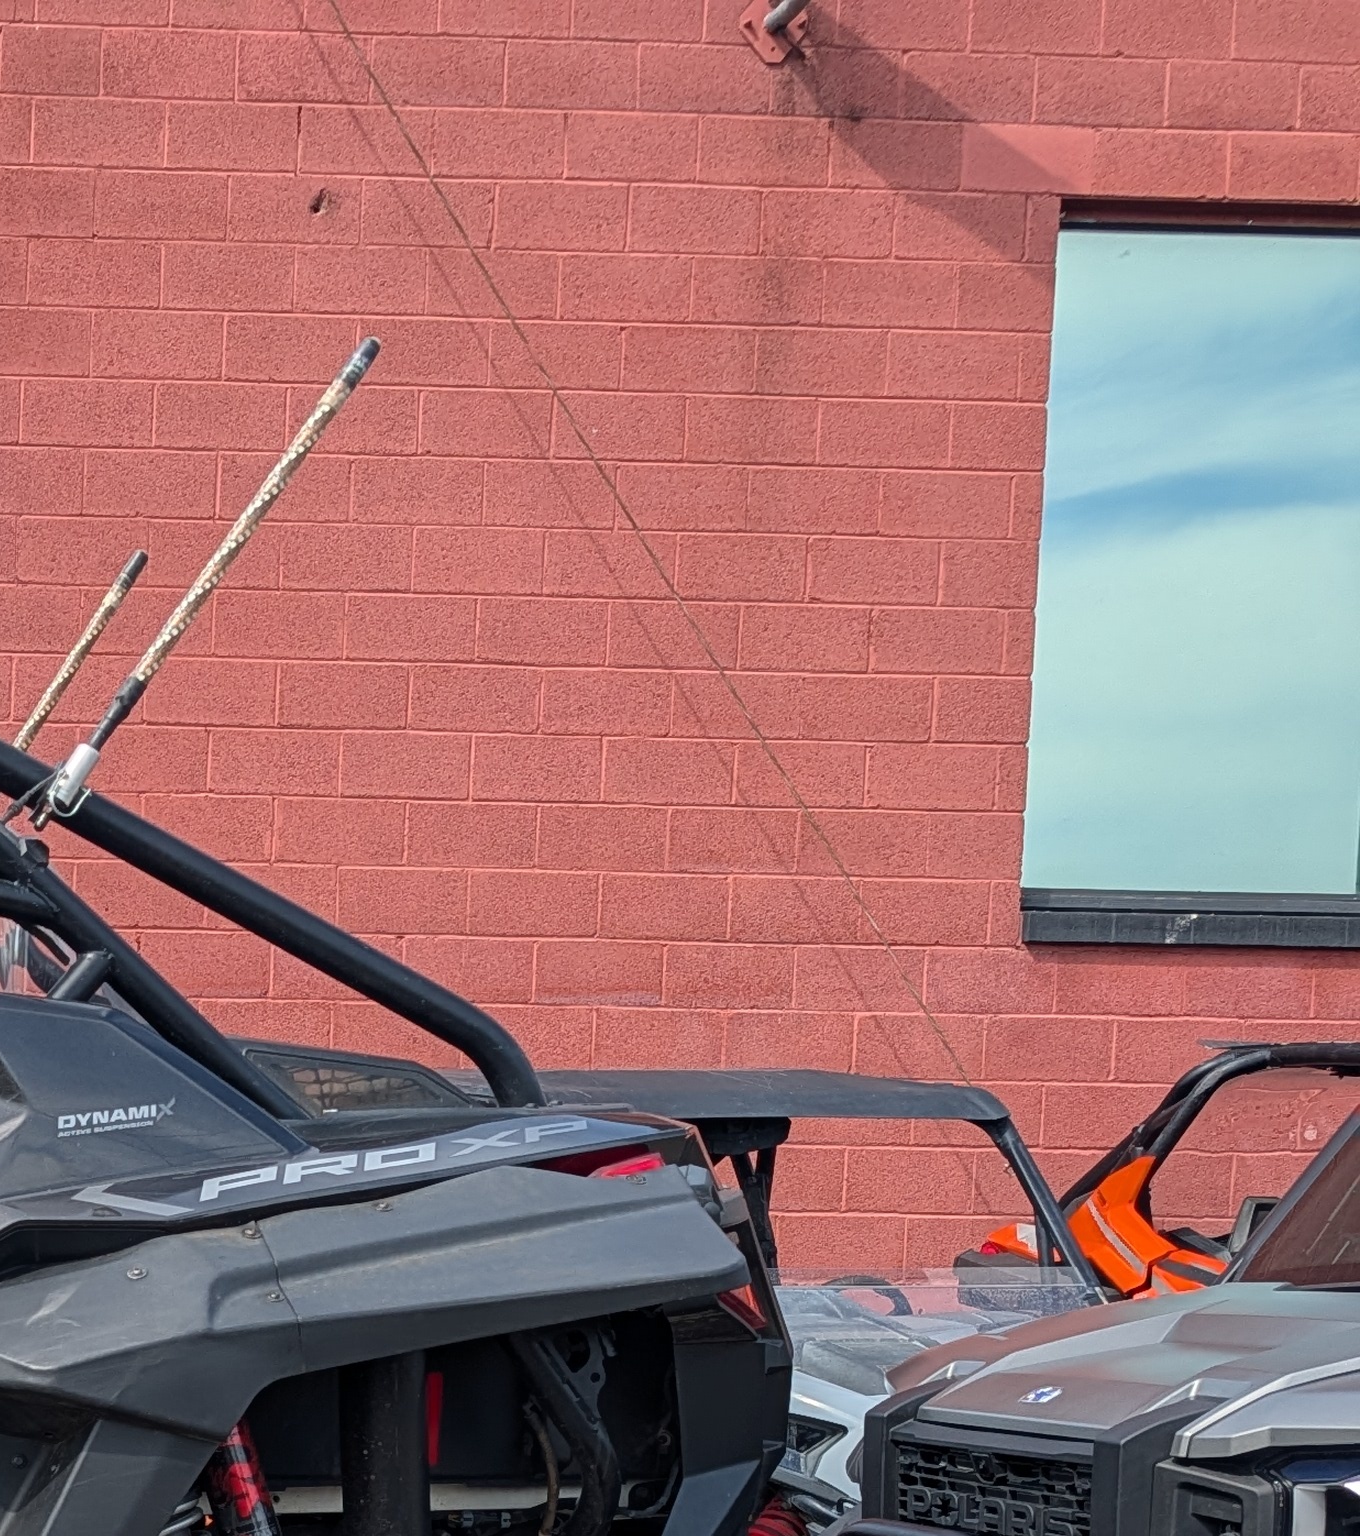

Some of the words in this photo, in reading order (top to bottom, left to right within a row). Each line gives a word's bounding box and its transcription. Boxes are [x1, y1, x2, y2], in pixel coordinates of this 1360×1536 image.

[57, 1095, 176, 1130] DYNAMIX
[57, 1128, 92, 1138] ACTIVE
[93, 1120, 154, 1134] SUSPENSION
[199, 1142, 437, 1202] PRO
[449, 1120, 588, 1158] XP
